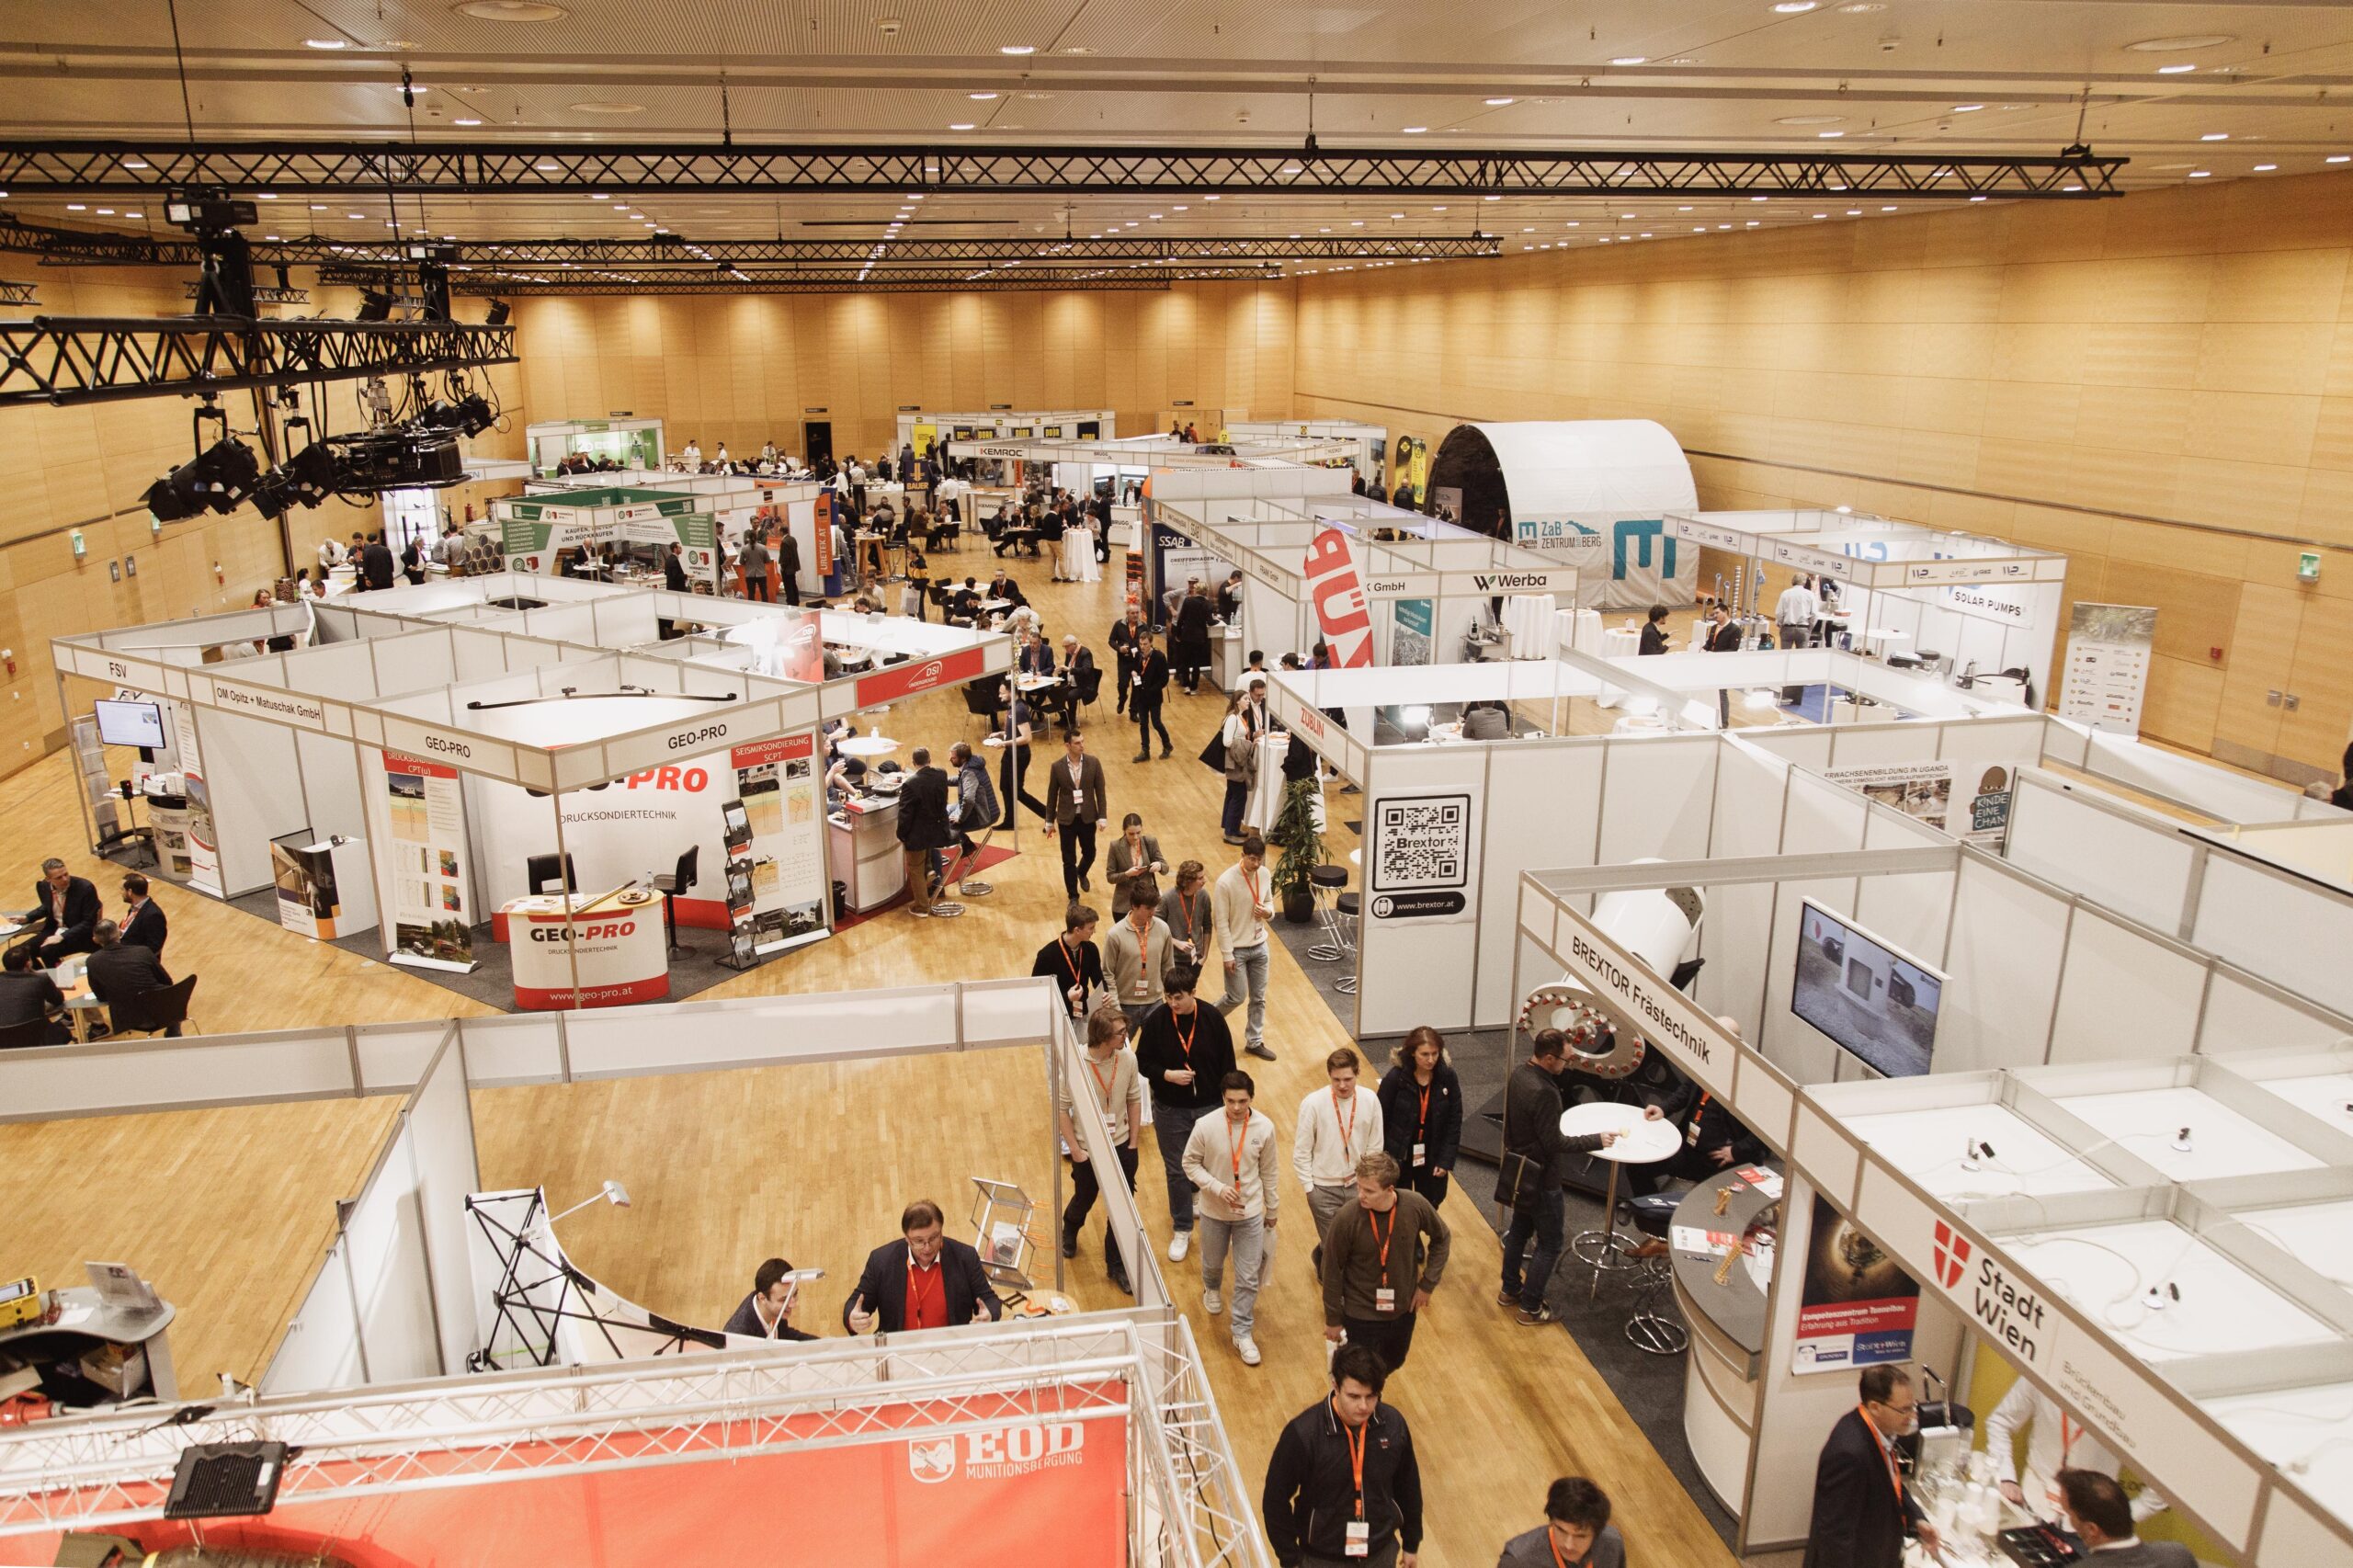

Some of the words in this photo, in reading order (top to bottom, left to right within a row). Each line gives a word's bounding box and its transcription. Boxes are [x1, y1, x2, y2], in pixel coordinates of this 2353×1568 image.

[980, 448, 1023, 457] KEMROC
[1541, 521, 1563, 537] ZaB
[1158, 536, 1186, 547] SSAB
[1541, 537, 1575, 550] ZENTRUM
[1582, 536, 1602, 548] BERG
[1374, 582, 1405, 592] GmbH
[1498, 573, 1547, 587] Werba
[1954, 591, 1984, 608] SOLAR
[1987, 600, 2021, 617] PUMPS
[108, 662, 128, 678] FSV
[926, 666, 939, 677] DSI
[217, 687, 228, 699] OM
[230, 690, 249, 704] Opitz
[256, 696, 296, 714] Matuschak
[296, 706, 322, 721] GmbH
[668, 724, 727, 750] GEO-PRO
[426, 736, 471, 758] GEO-PRO
[735, 736, 809, 756] SEISMIKSONDIERUNG
[764, 751, 783, 762] SCPT
[408, 765, 431, 777] CPT(u)
[1824, 766, 1909, 778] ERWACHSENENBILDUNG
[1919, 765, 1949, 773] UGANDA
[1976, 794, 2010, 808] KINDE
[560, 810, 677, 824] DRUCKSONDIERTECHNIK
[1976, 807, 2000, 819] EINE
[1975, 815, 2006, 828] CHAN
[1396, 835, 1446, 849] Brextor
[1396, 898, 1455, 911] www.brextor.at
[530, 921, 636, 942] GEO-PRO
[548, 945, 618, 955] DRUCKSNDIERTECHNIK
[550, 986, 632, 1002] wwwgeo-pro.at
[1573, 936, 1630, 996] BREXTOR
[1632, 984, 1711, 1065] Frästechnik
[1978, 1257, 2046, 1332] Stadt
[1802, 1307, 1869, 1322] Kompetenzzentrum
[1802, 1322, 1835, 1332] Erfahrung
[1849, 1316, 1880, 1326] Tradition
[1974, 1286, 2038, 1362] Wien
[2059, 1380, 2080, 1403] und
[965, 1423, 1084, 1464] EOD
[966, 1450, 1083, 1480] MUNITIONSBERGUNG
